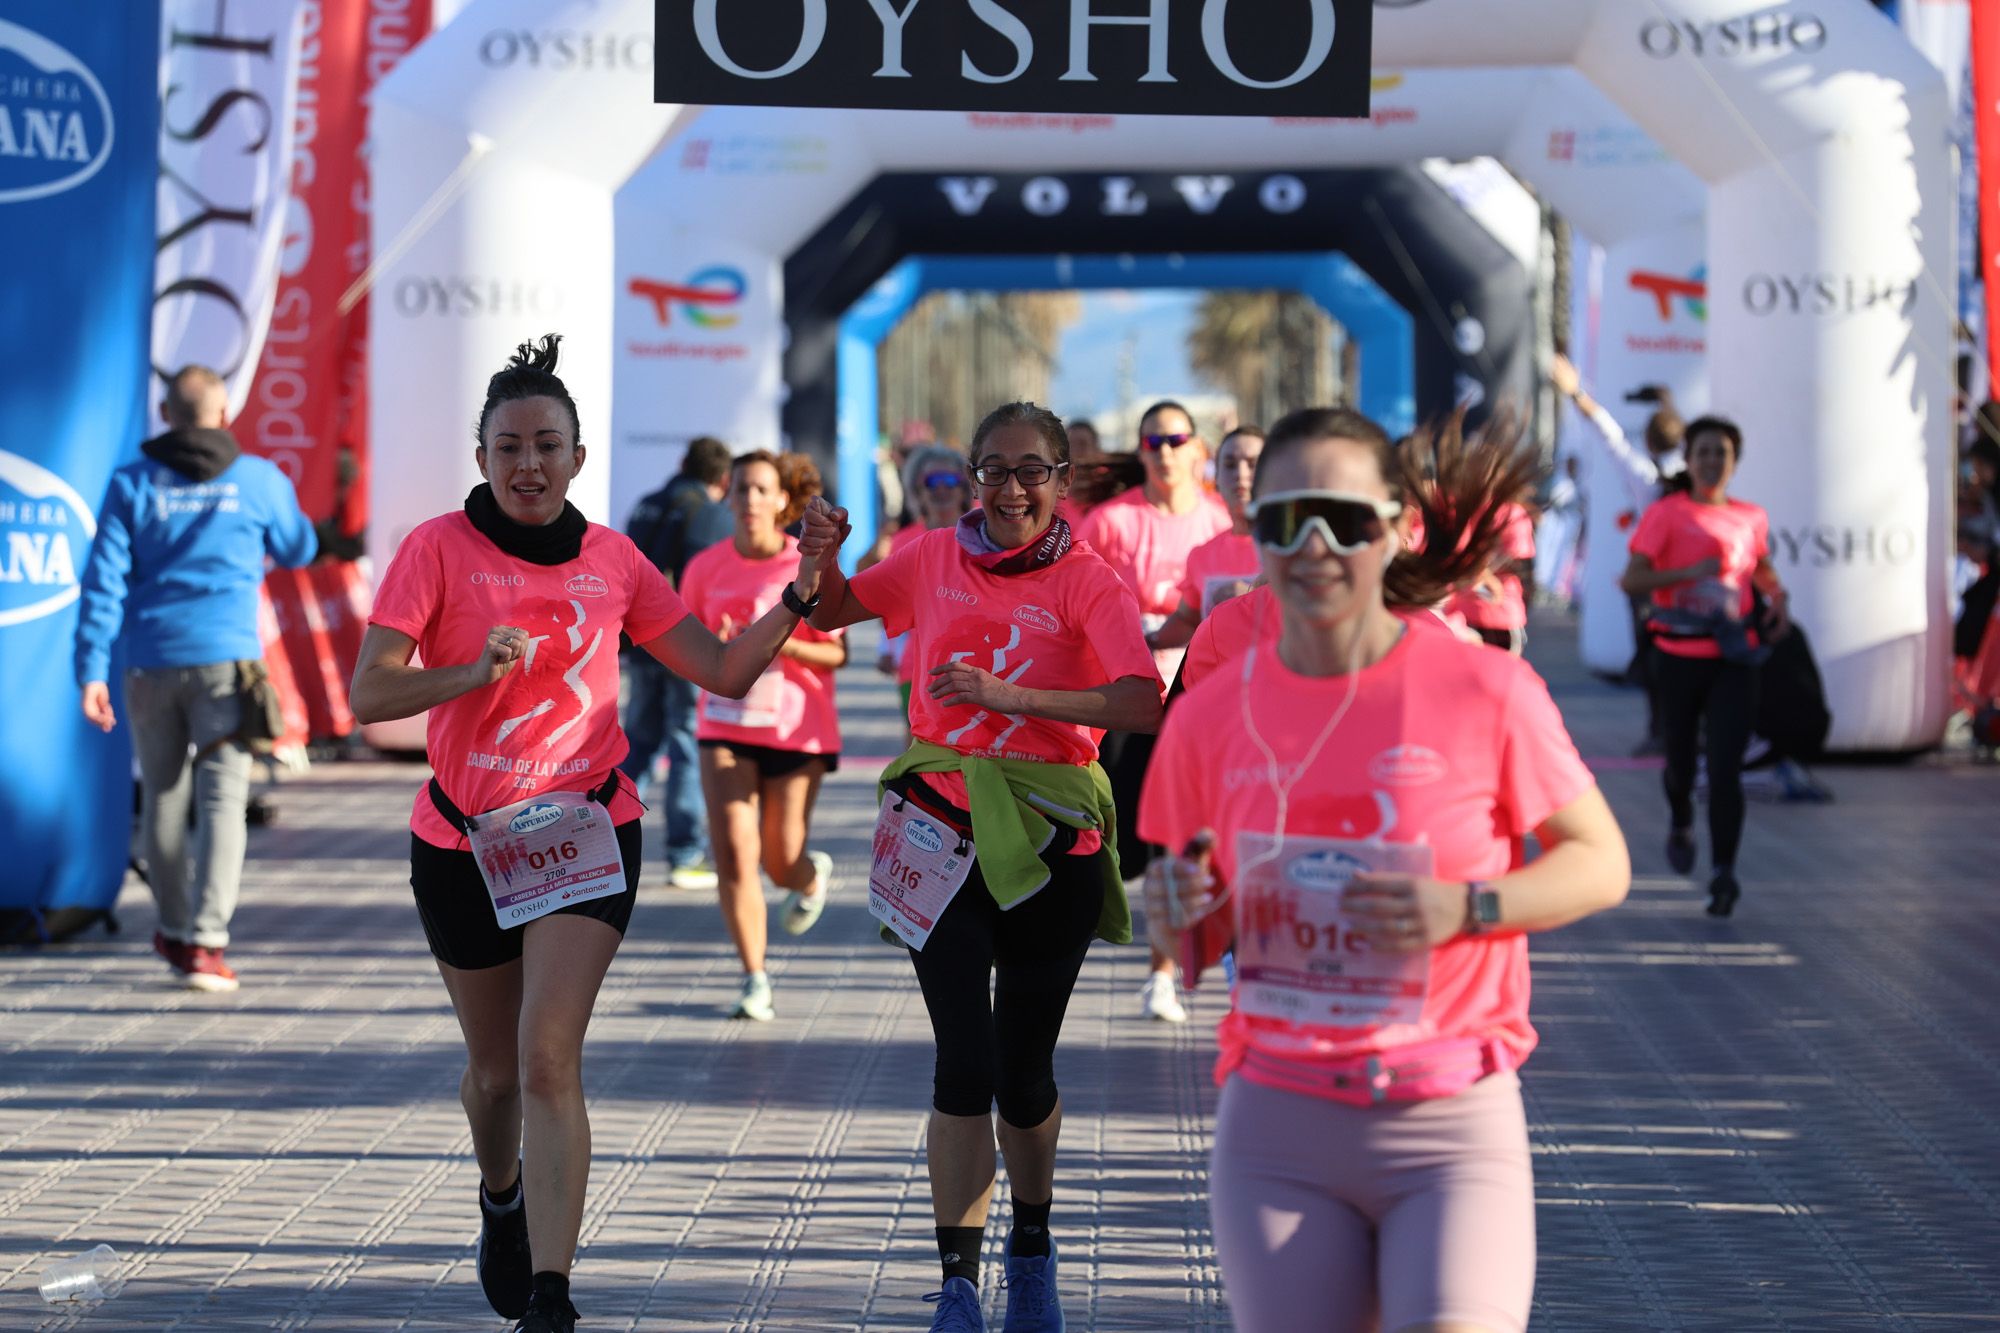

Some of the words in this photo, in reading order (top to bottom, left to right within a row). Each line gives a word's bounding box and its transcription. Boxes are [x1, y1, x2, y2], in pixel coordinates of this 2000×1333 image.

[479, 26, 655, 74] OYSHO
[692, 0, 1336, 89] OYSHO
[1640, 13, 1827, 59] OYSHO
[938, 174, 1307, 216] VOLVO
[394, 274, 563, 319] OYSHO
[1743, 274, 1917, 318] OYSHO
[471, 571, 526, 588] OYSHO
[936, 586, 978, 606] OYSHO
[1014, 609, 1056, 631] ASTURIANA
[513, 775, 537, 790] 2025
[515, 759, 533, 775] DE
[534, 759, 549, 777] LA
[513, 810, 561, 832] ASTURIANA
[905, 823, 939, 851] ASTURIANA
[528, 840, 579, 870] 016
[510, 889, 537, 903] CARRERA
[537, 886, 546, 894] DE
[546, 883, 554, 892] LA
[554, 877, 573, 889] MUJER
[577, 868, 607, 881] VALENCIA
[544, 867, 567, 882] 2700
[889, 858, 923, 890] 016
[511, 898, 549, 919] OYSHO
[572, 882, 611, 898] Santander
